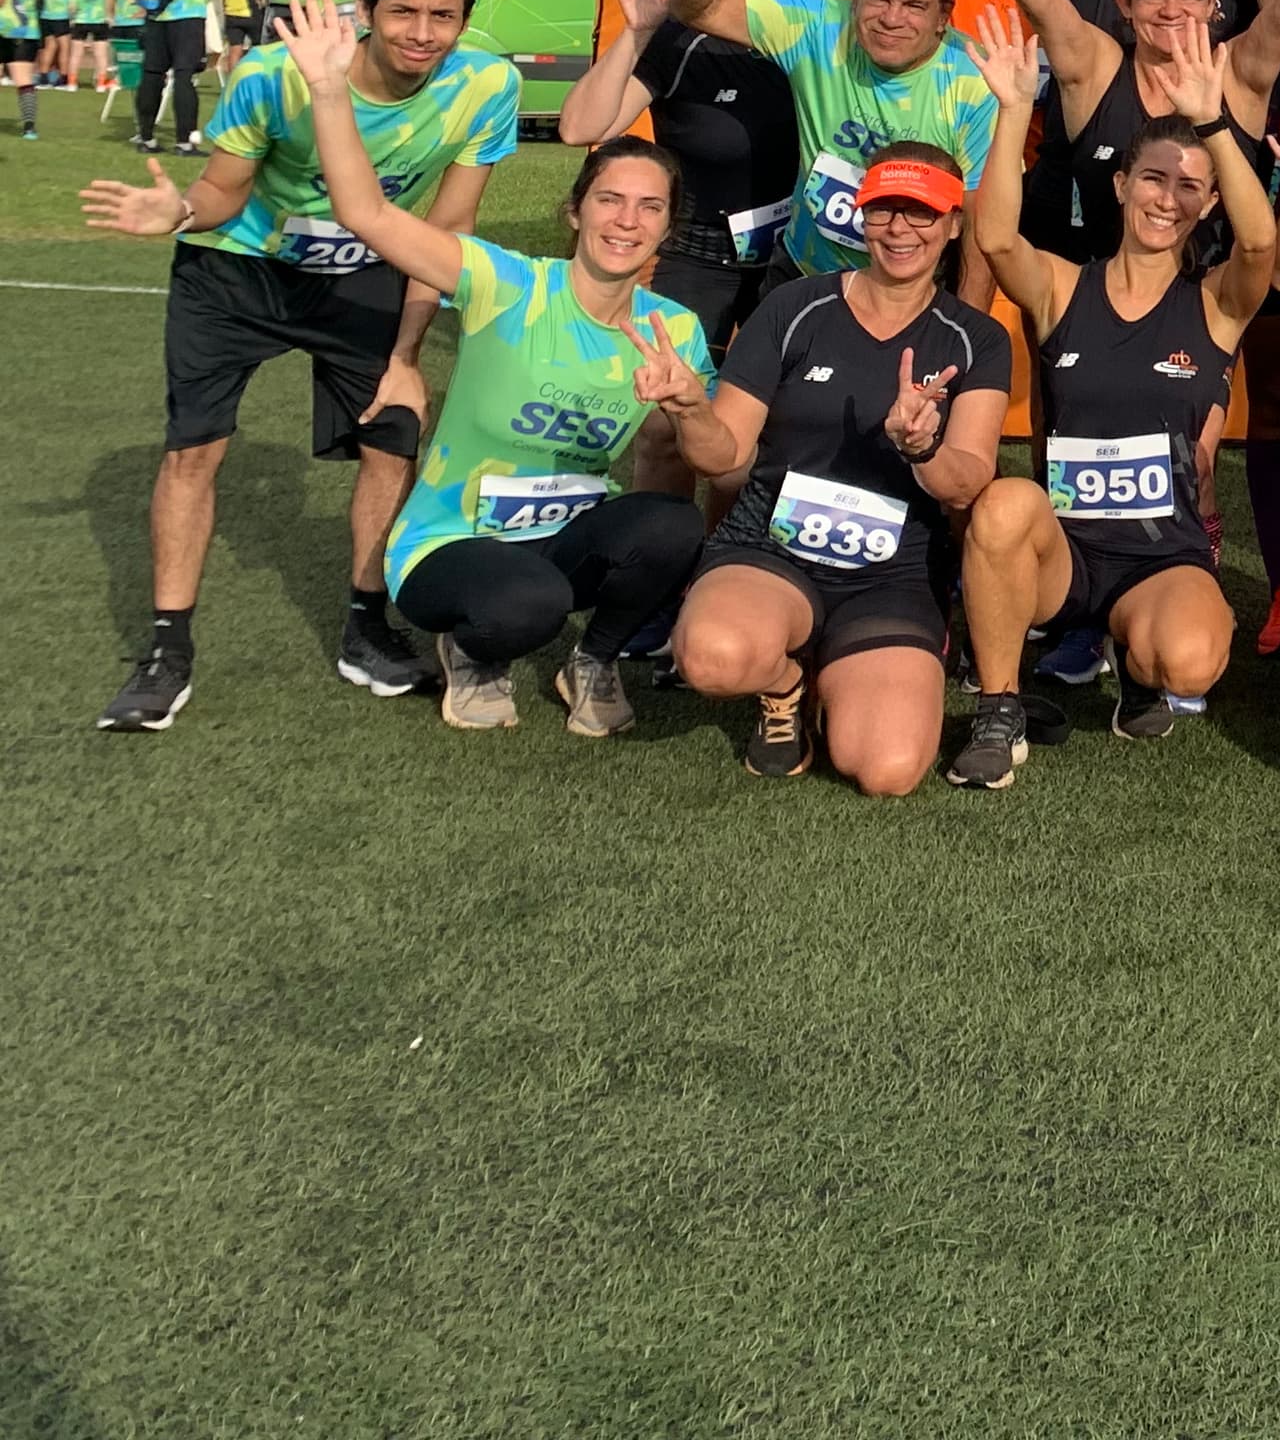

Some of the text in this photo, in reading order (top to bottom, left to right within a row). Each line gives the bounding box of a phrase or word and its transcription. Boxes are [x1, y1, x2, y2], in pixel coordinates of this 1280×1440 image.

[539, 381, 629, 416] Corrida do
[510, 401, 632, 452] SESI
[1096, 447, 1120, 457] SESI
[834, 493, 862, 507] SESI
[1076, 464, 1169, 504] 950
[797, 513, 898, 564] 839
